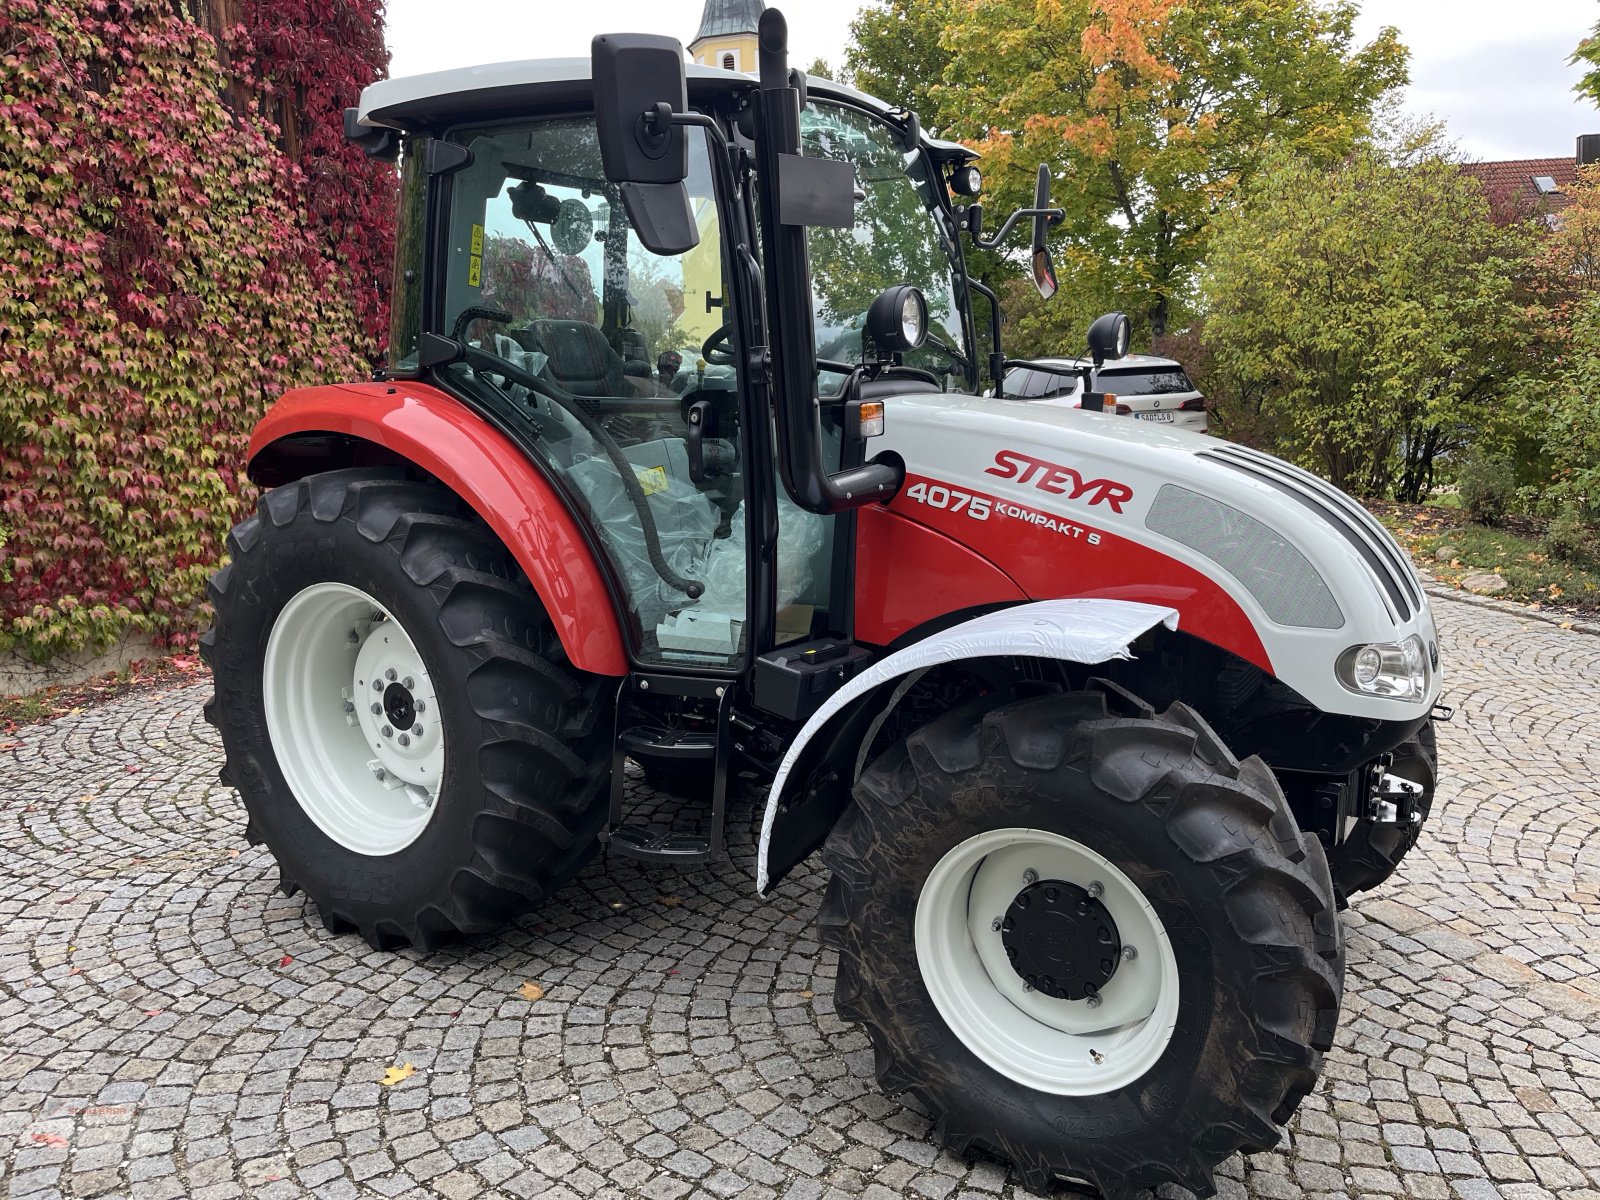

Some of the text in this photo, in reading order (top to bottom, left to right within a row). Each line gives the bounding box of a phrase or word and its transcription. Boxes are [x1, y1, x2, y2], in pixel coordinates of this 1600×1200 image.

[906, 482, 1101, 547] 4075 KOMPAKT S
[984, 449, 1134, 515] STEYR
